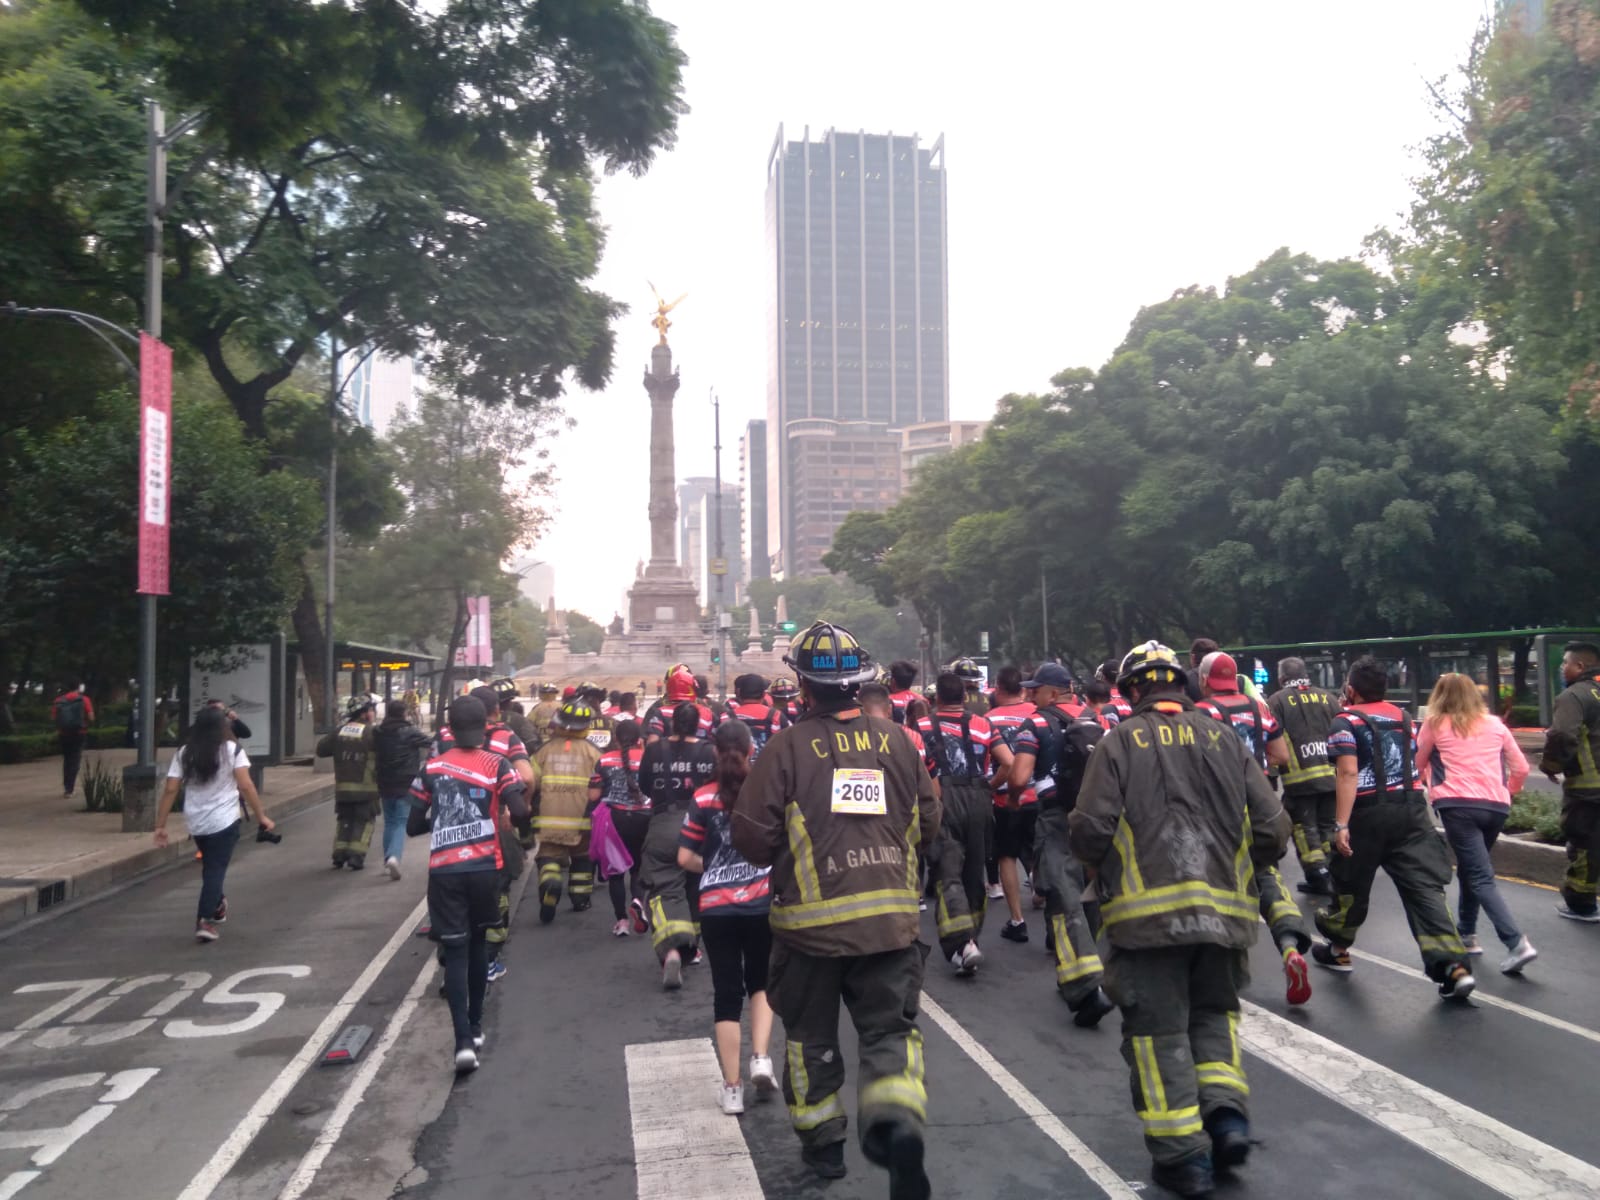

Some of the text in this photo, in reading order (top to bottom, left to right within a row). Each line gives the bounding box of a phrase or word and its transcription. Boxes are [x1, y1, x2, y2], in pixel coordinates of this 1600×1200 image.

[1288, 693, 1329, 706] CDMX
[811, 731, 891, 758] CDMX
[1132, 724, 1222, 752] CDMX
[841, 784, 880, 802] 2609
[847, 846, 902, 868] GALINDO
